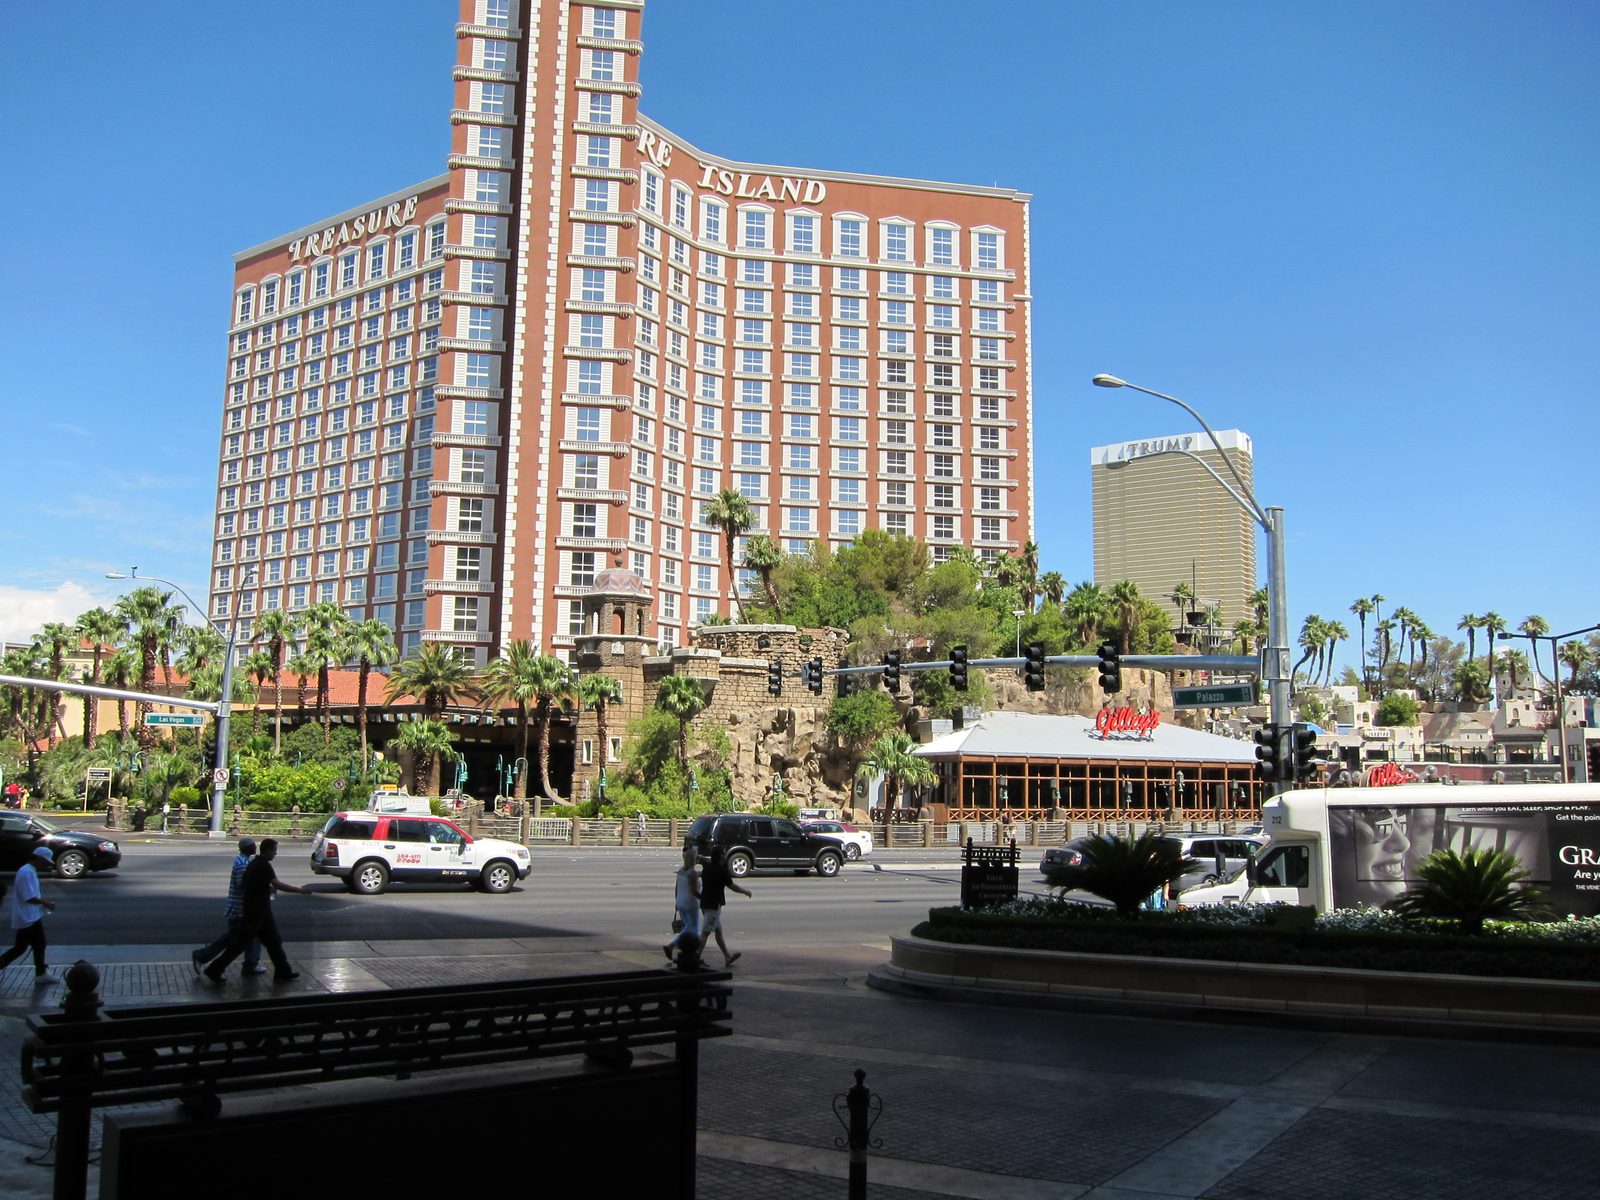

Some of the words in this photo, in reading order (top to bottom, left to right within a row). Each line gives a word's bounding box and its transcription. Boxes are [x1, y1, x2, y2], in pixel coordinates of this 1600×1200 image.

[697, 162, 827, 204] ISLAND
[288, 194, 418, 263] TREASURE
[1127, 436, 1193, 457] TRUMP
[1196, 691, 1225, 702] Palazzo
[169, 716, 185, 724] Vegas
[1096, 706, 1160, 738] Gilley's
[1272, 816, 1282, 824] 212
[1573, 869, 1592, 880] Are
